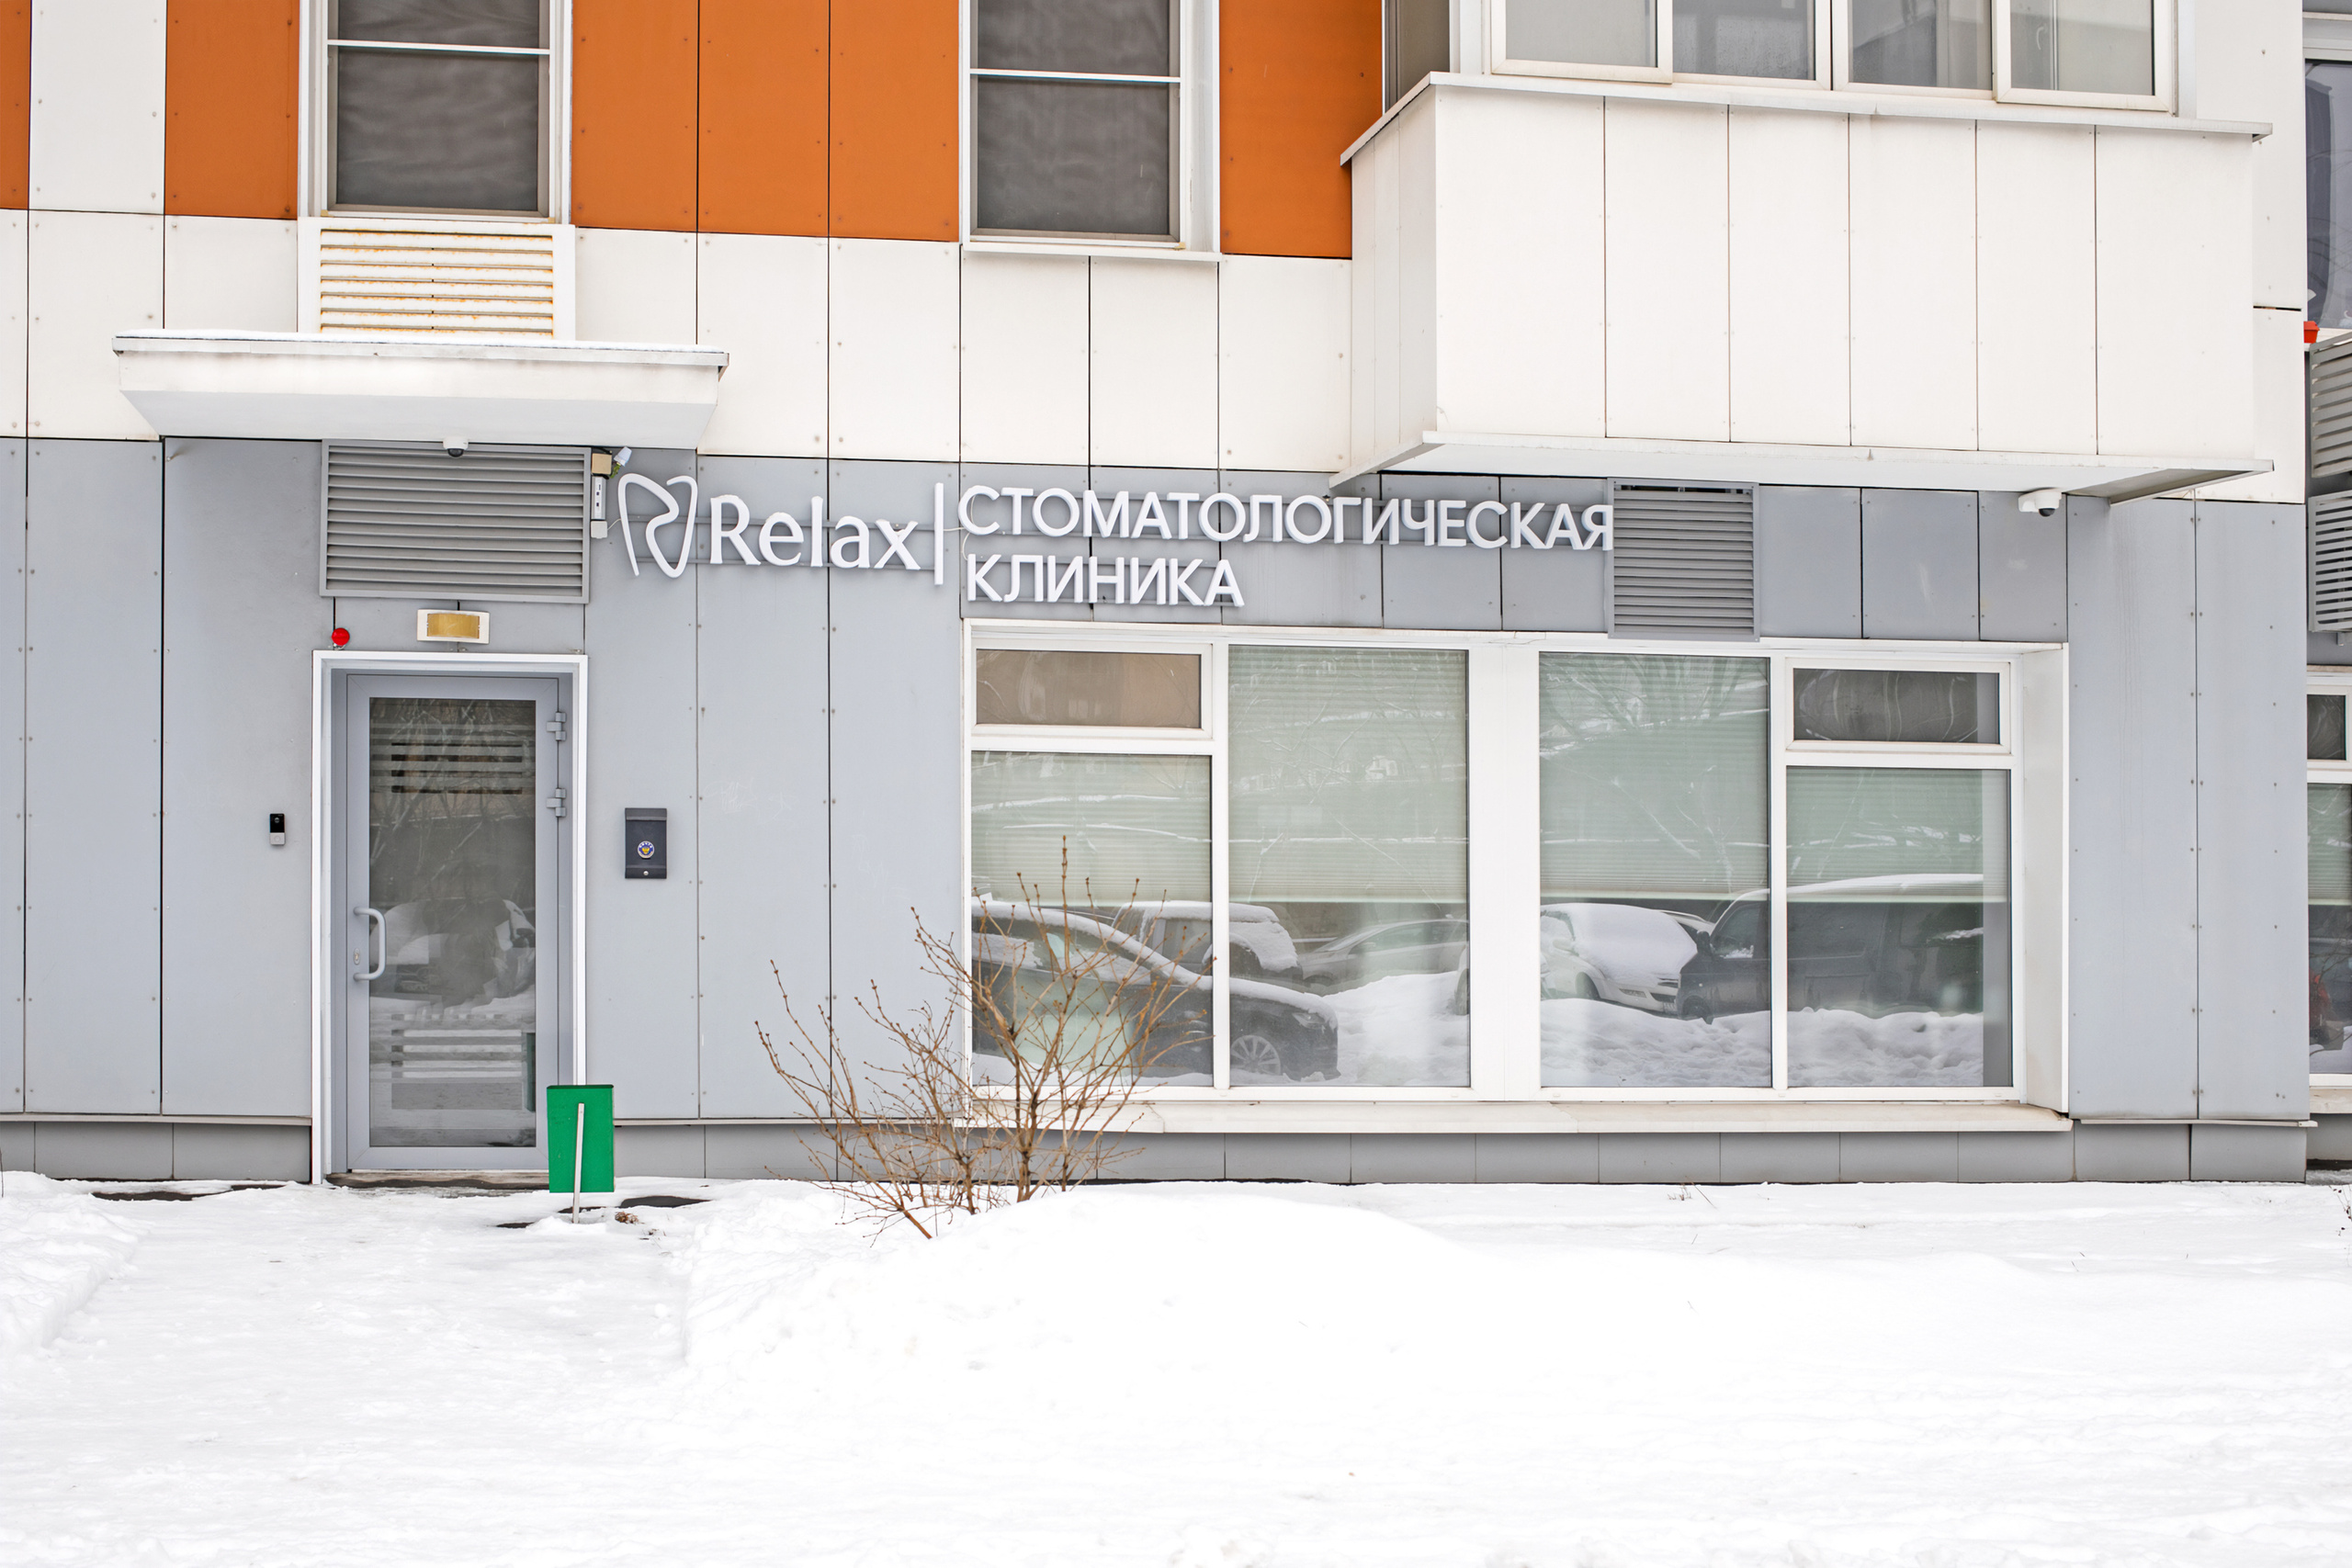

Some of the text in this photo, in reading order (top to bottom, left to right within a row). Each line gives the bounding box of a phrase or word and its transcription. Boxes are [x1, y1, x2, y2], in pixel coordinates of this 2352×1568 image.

[708, 493, 922, 571] Relax
[957, 484, 1614, 551] СТОМАТОЛОГИЧЕСКАЯ
[967, 553, 1245, 607] КЛИНИКА
